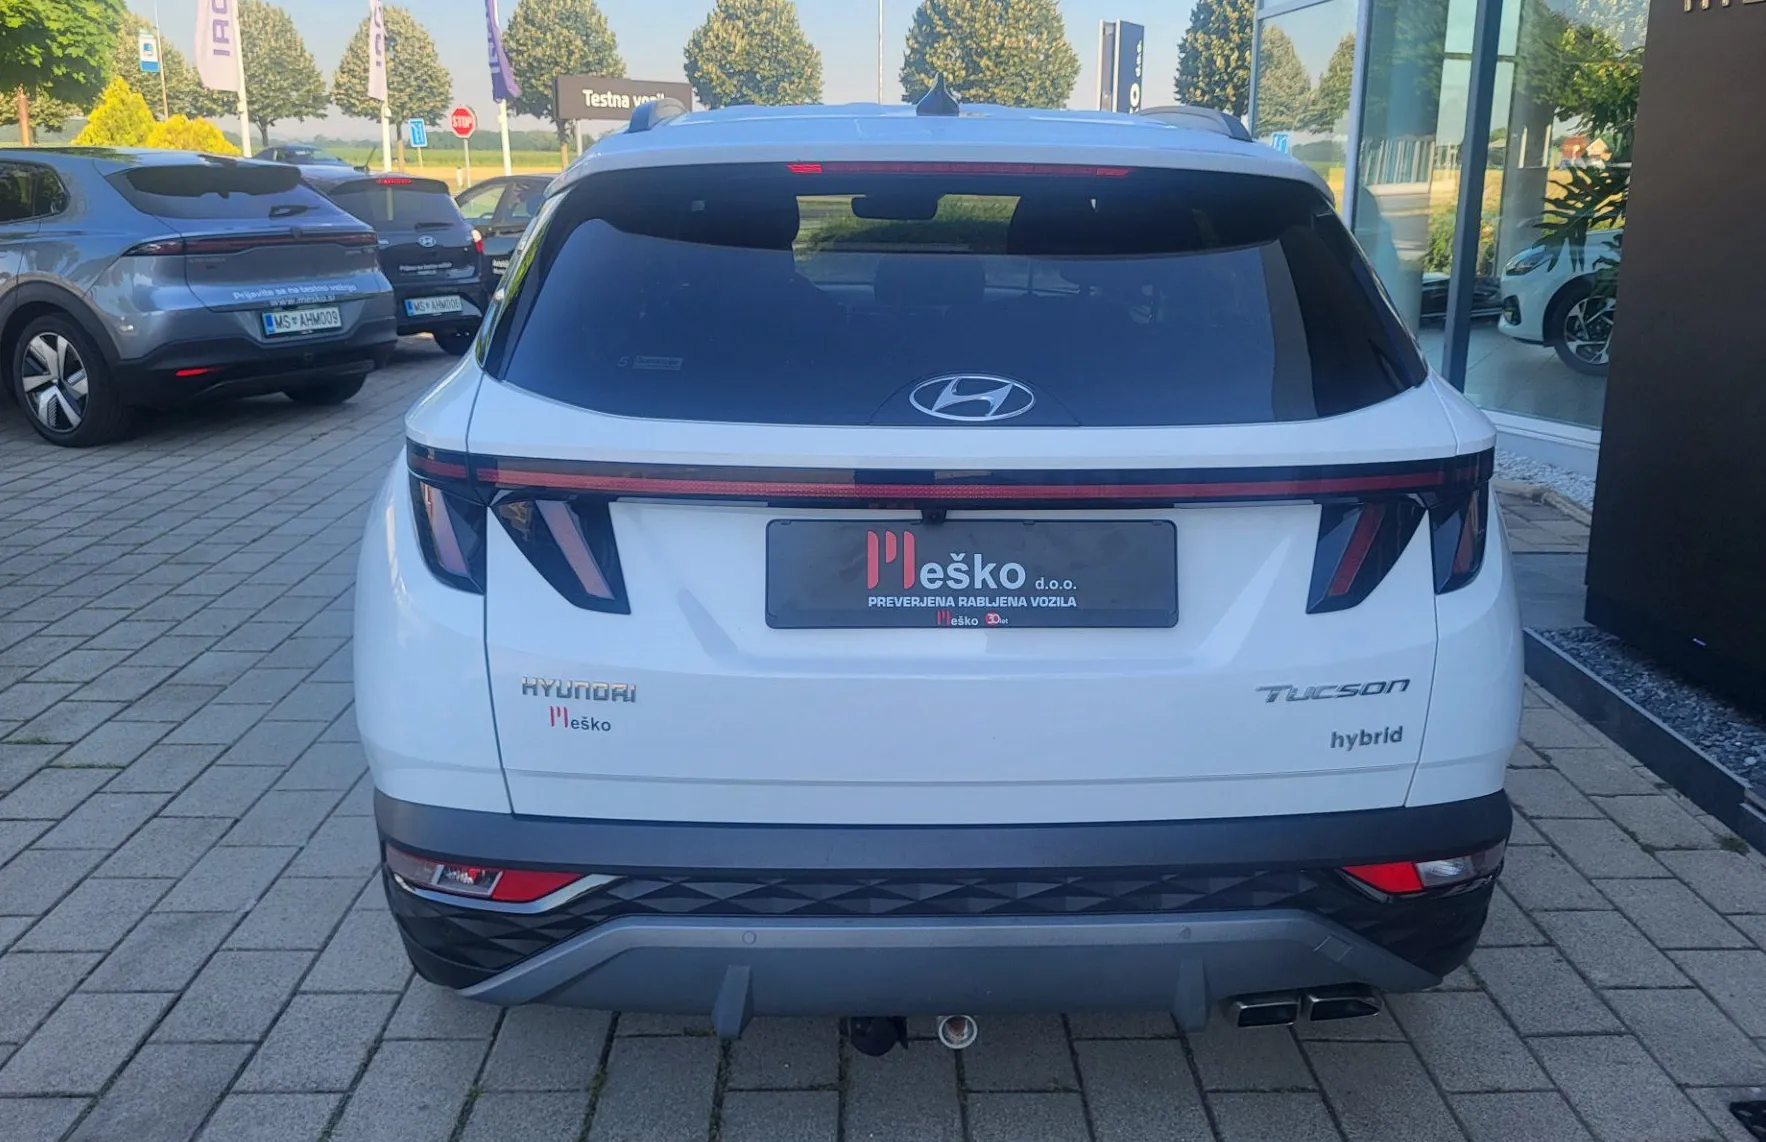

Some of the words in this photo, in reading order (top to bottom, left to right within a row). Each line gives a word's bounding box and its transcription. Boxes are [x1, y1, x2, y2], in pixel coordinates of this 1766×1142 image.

[582, 88, 630, 109] Testna
[452, 115, 472, 128] STOP
[274, 315, 291, 330] MS
[300, 309, 339, 326] AHM009
[1035, 577, 1077, 590] d.o.o.
[868, 596, 955, 608] PREVERJENA
[958, 596, 1027, 608] RABLJENA
[1030, 596, 1077, 608] VOZILA
[521, 676, 637, 703] HYUNDAI
[1330, 725, 1404, 751] hybrid
